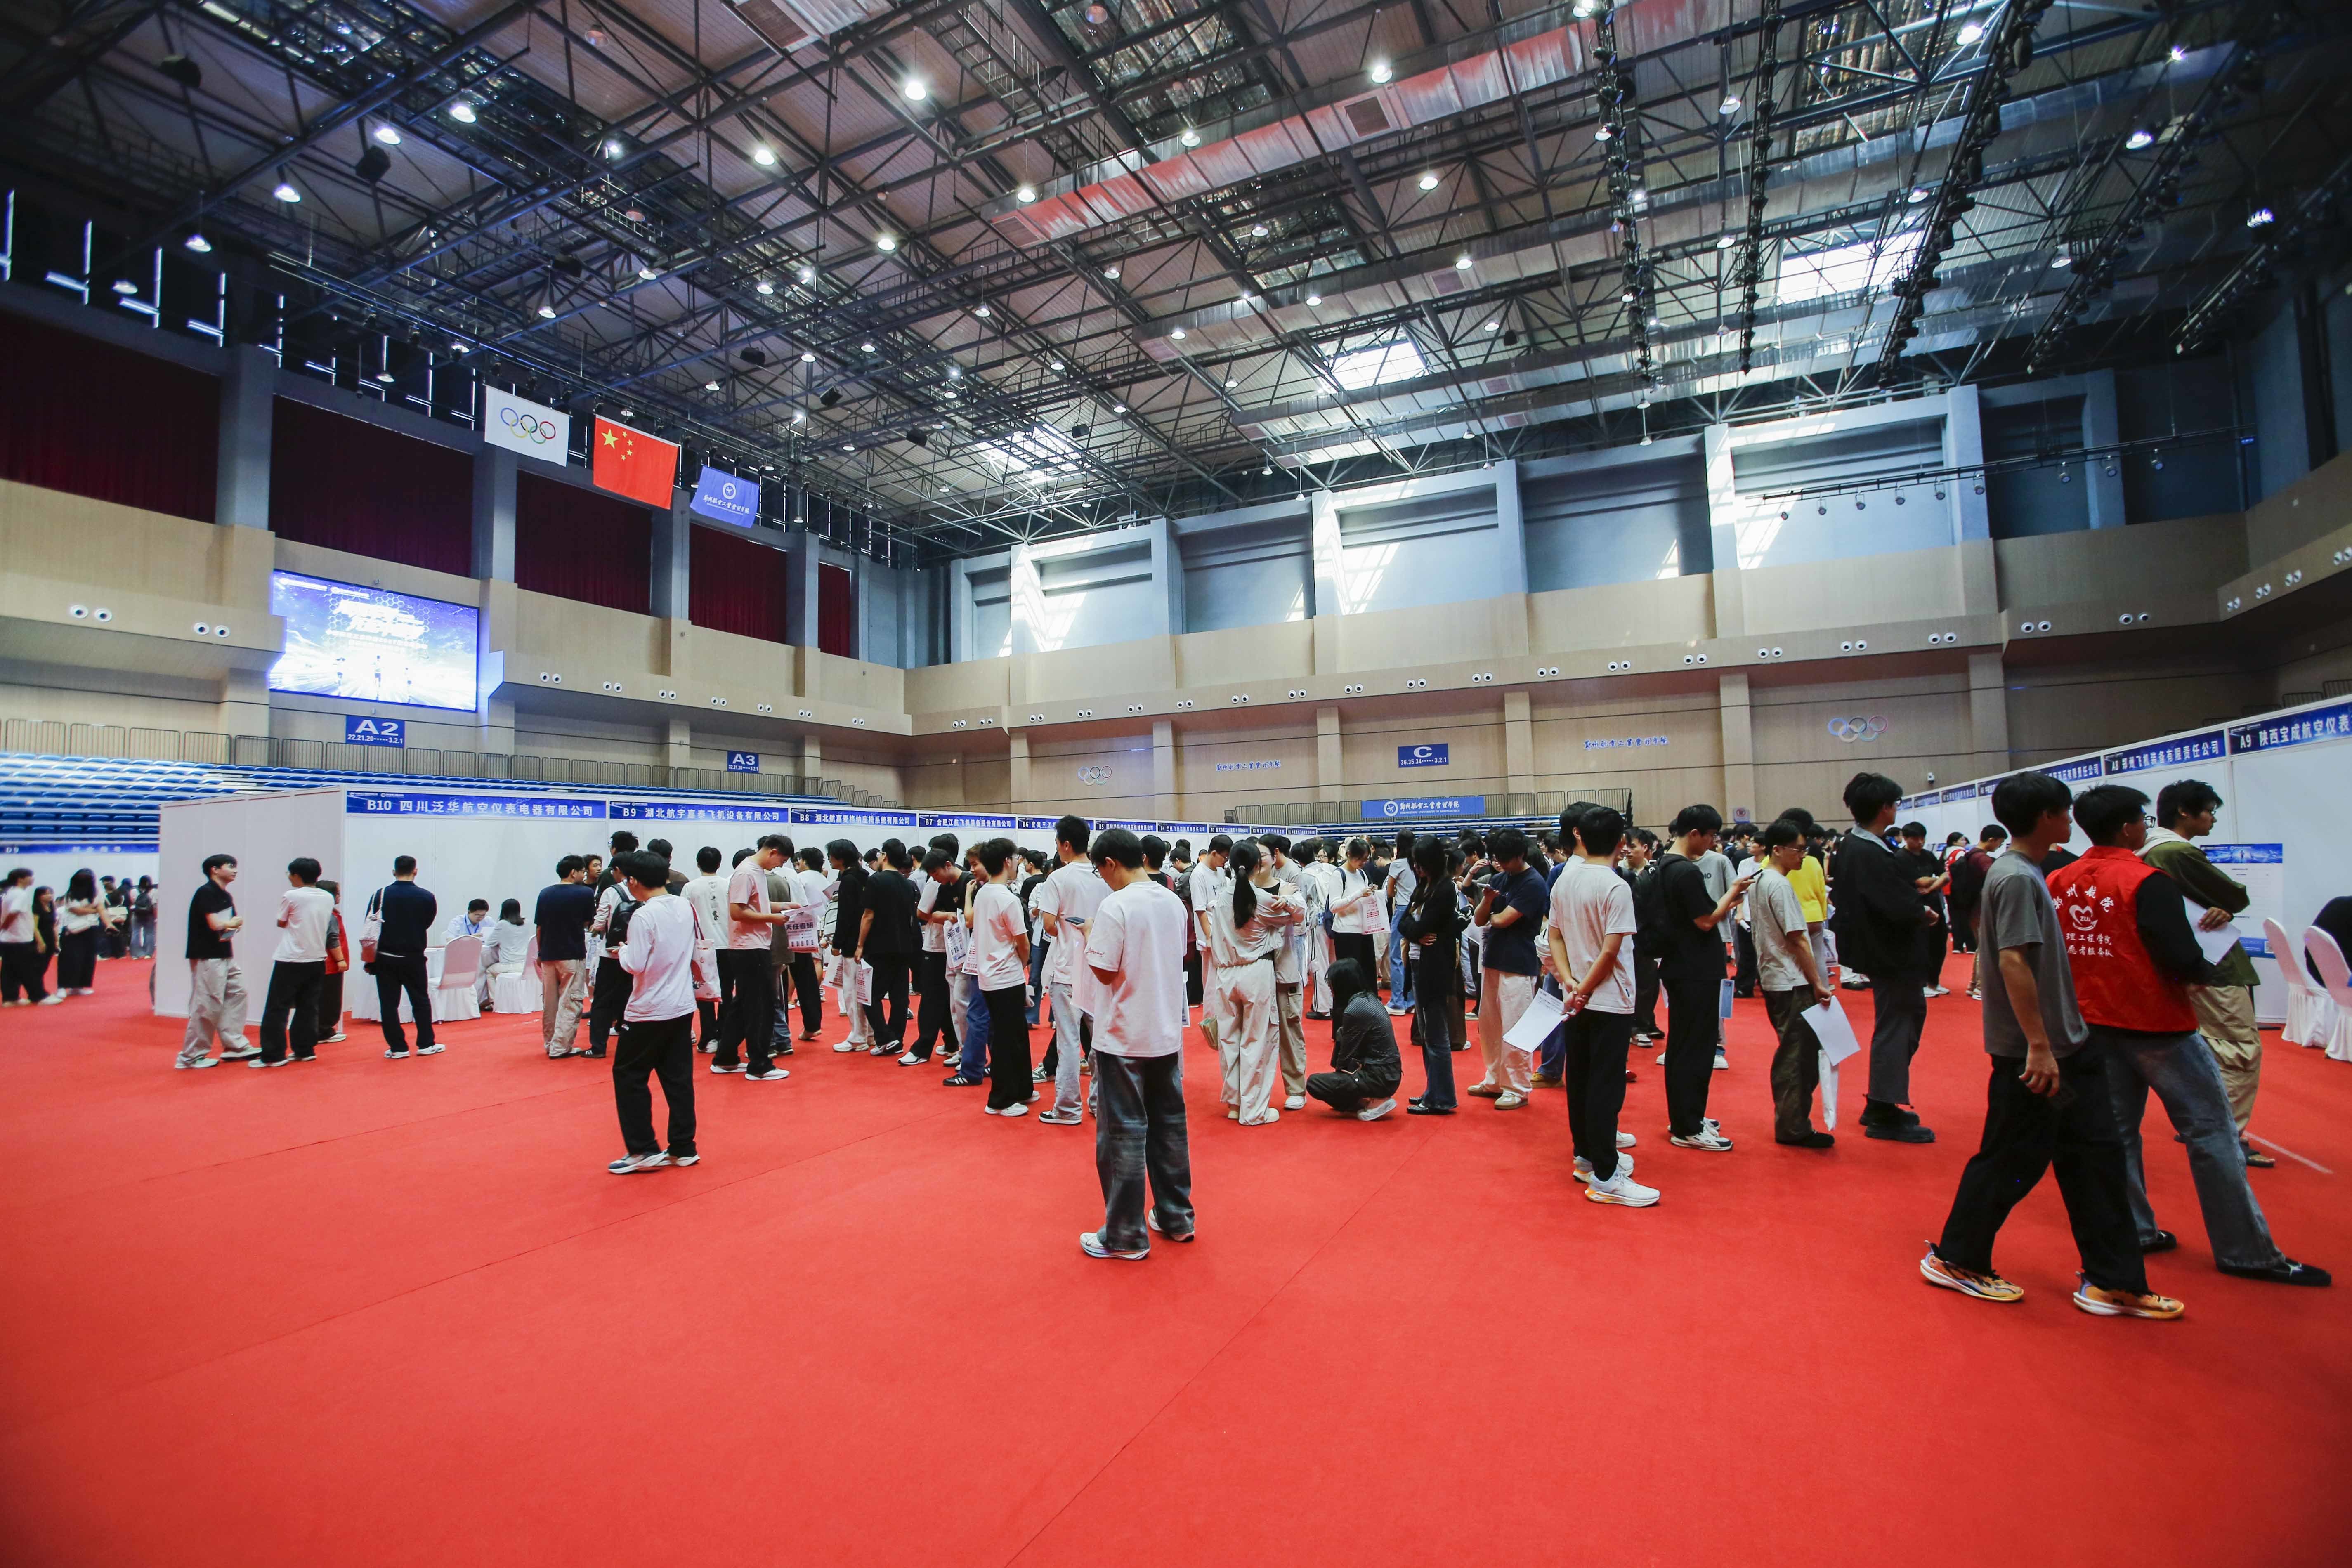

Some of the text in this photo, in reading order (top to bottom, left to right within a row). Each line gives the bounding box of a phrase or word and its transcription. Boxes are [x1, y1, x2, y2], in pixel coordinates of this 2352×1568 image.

[355, 720, 398, 736] A2
[2240, 714, 2352, 749] A9 陕西宝成航空仪表
[732, 753, 755, 765] A3
[1414, 746, 1432, 758] C
[367, 800, 592, 816] B10 四川泛华航空仪表电器有限公司
[623, 808, 779, 821] B9 湖北航宇嘉泰飞机设备有限公司
